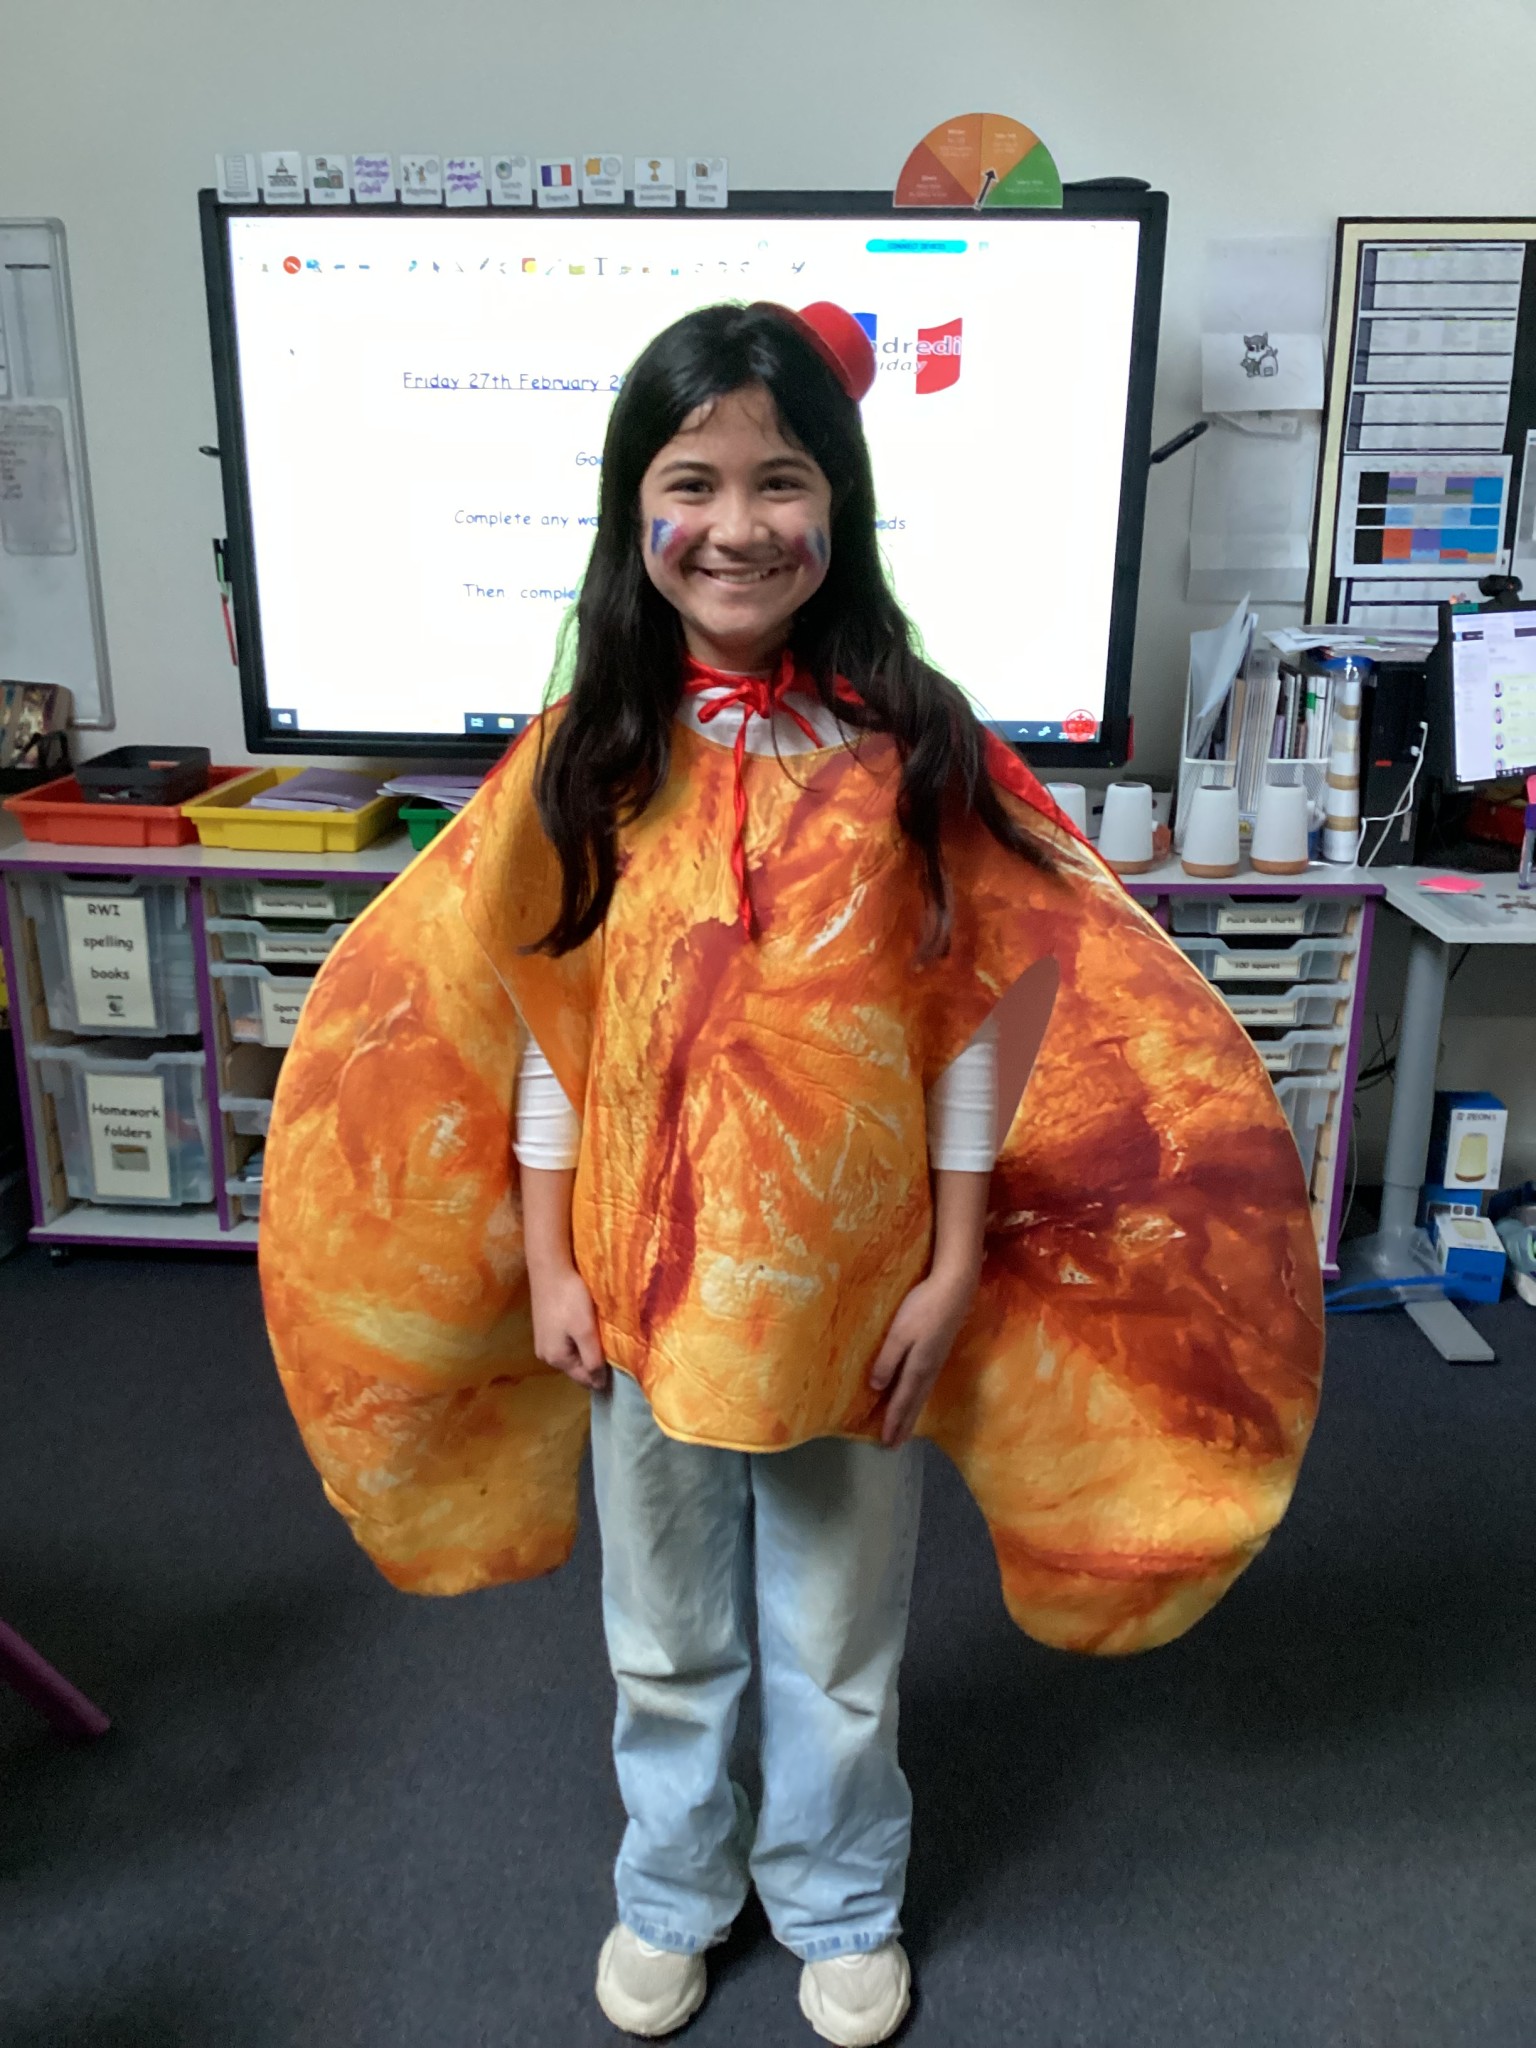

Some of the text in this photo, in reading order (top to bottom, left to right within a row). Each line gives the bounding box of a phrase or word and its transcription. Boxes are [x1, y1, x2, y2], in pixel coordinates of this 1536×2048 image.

[880, 358, 928, 375] iday
[403, 372, 460, 391] Friday
[469, 373, 511, 389] 27th
[520, 373, 600, 392] February
[454, 510, 600, 528] Complete any wo
[463, 584, 579, 602] Then comple
[87, 903, 121, 916] RWI
[83, 935, 134, 952] spelling
[90, 966, 130, 980] books
[1235, 961, 1249, 969] 100
[92, 1103, 161, 1118] Homework
[104, 1124, 152, 1139] folders
